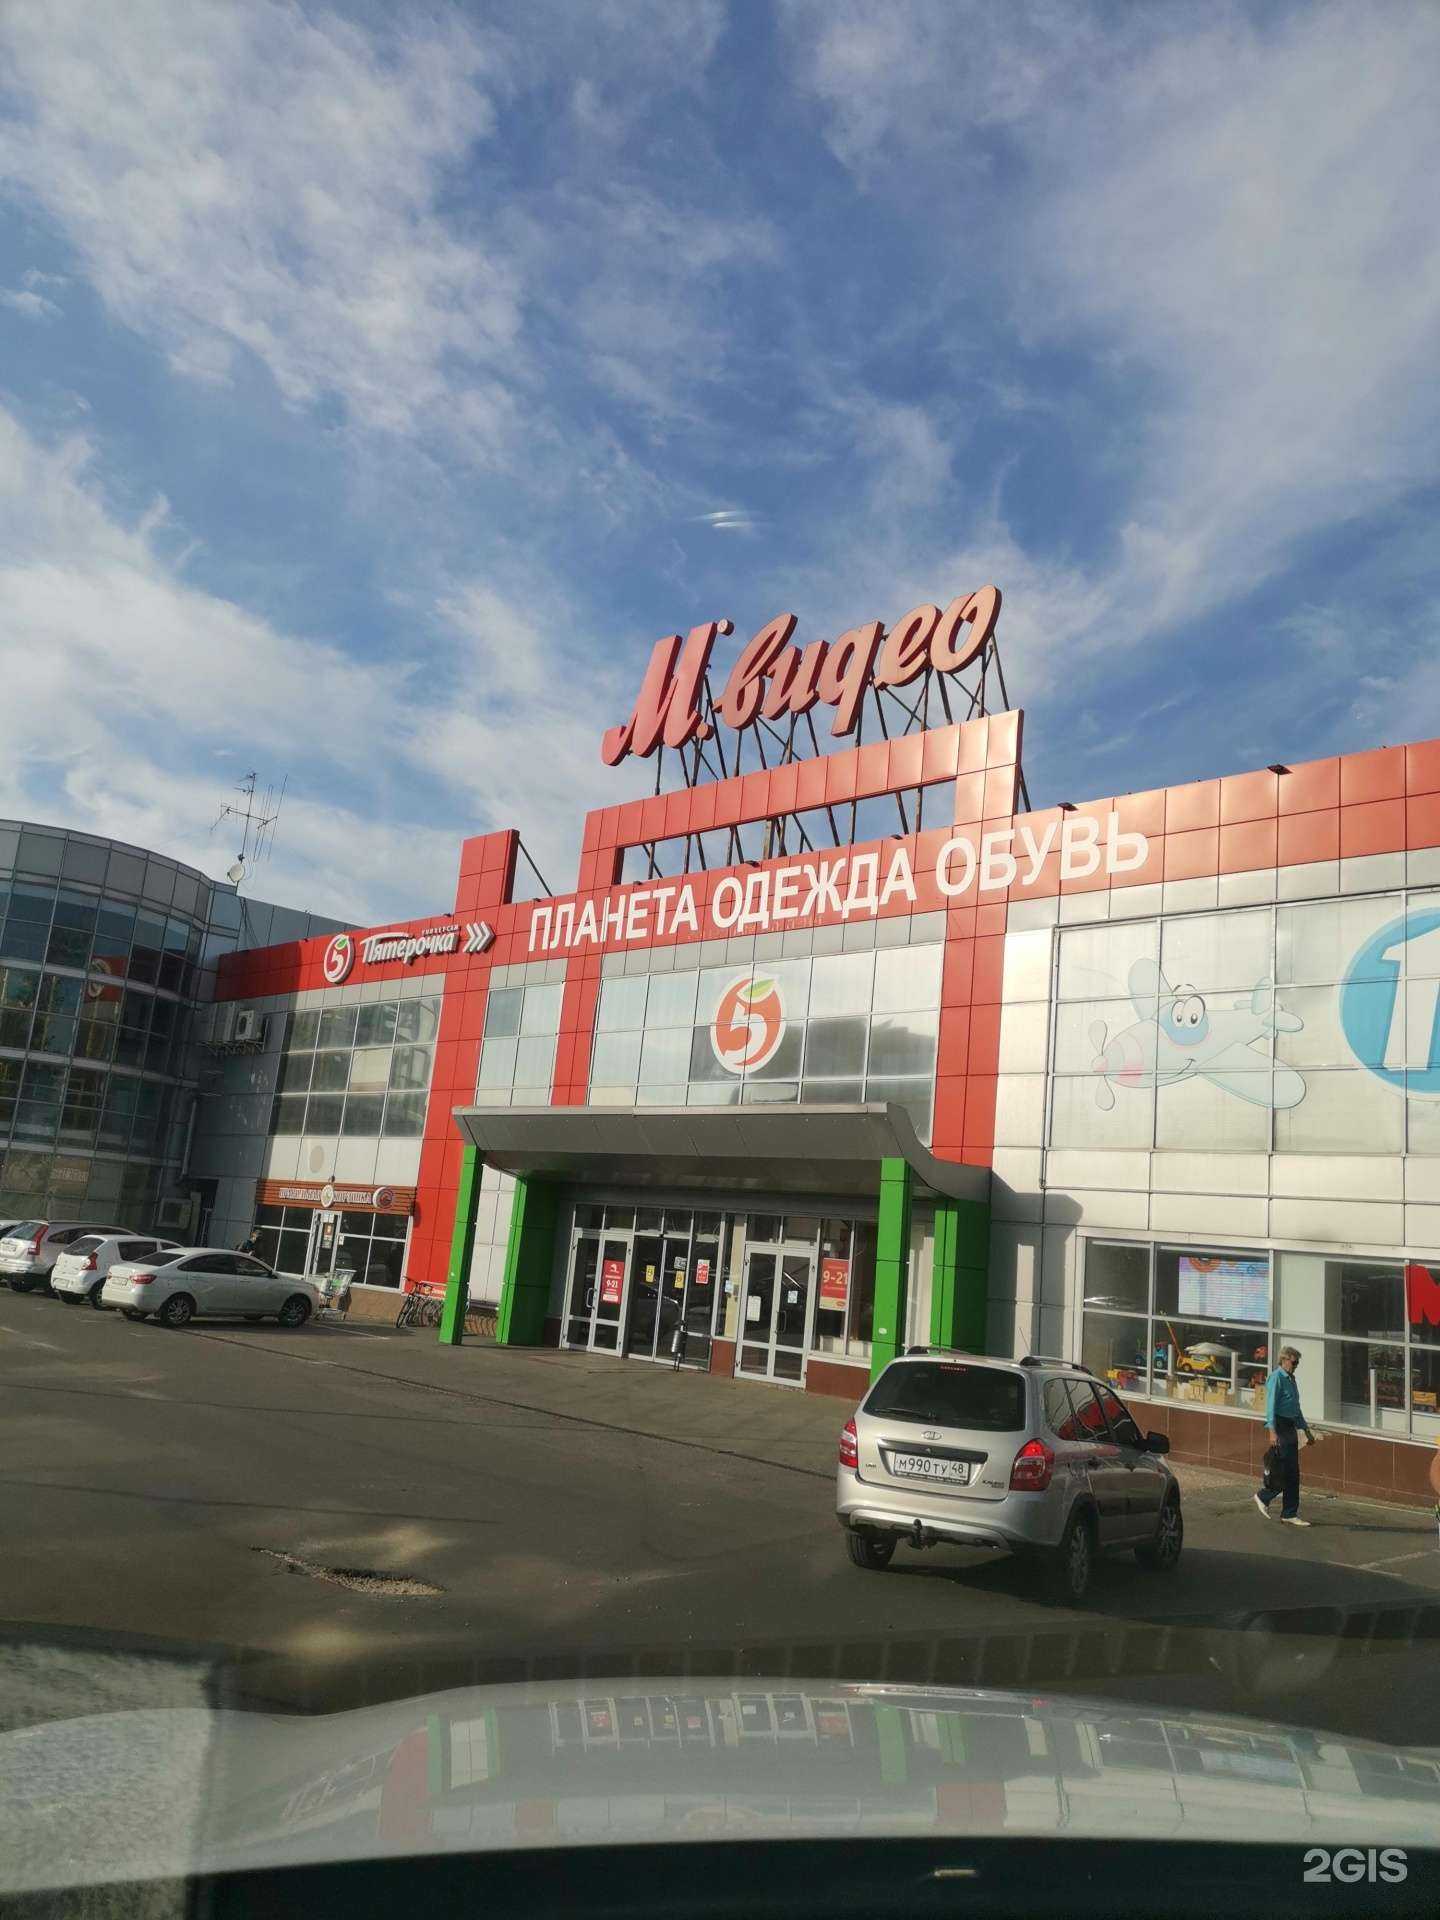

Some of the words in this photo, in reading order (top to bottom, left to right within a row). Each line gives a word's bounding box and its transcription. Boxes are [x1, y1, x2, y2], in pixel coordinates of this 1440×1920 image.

[528, 884, 698, 952] ПЛАНЕТА
[711, 848, 917, 932] ОДЕЖДА
[935, 811, 1149, 896] ОБУВЬ
[823, 1270, 848, 1285] 9-21
